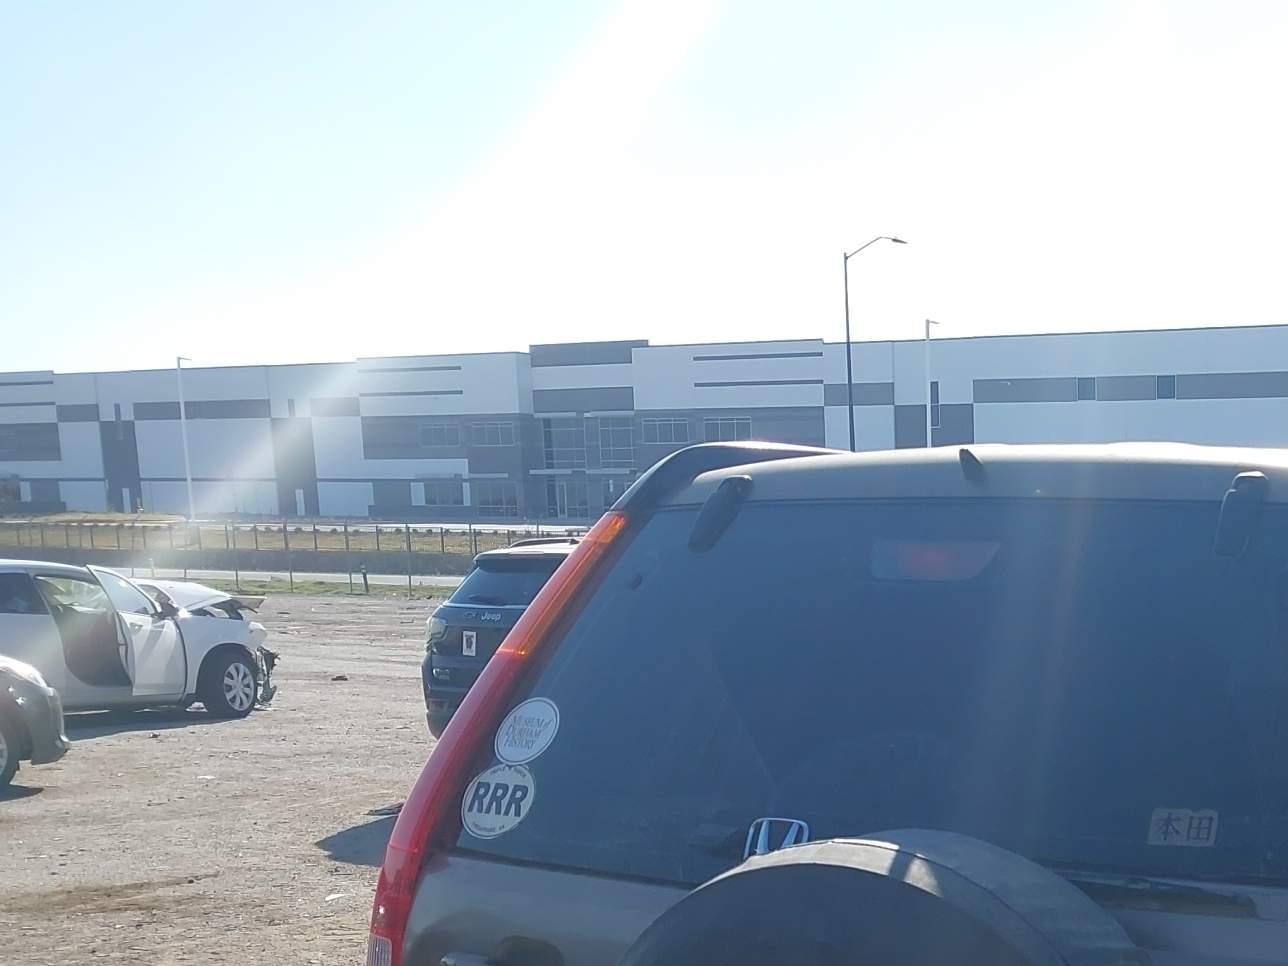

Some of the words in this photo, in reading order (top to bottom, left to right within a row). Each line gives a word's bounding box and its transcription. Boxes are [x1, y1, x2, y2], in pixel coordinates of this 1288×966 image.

[481, 611, 502, 621] Jeep
[467, 781, 529, 817] RRR
[1155, 811, 1214, 842] 本田
